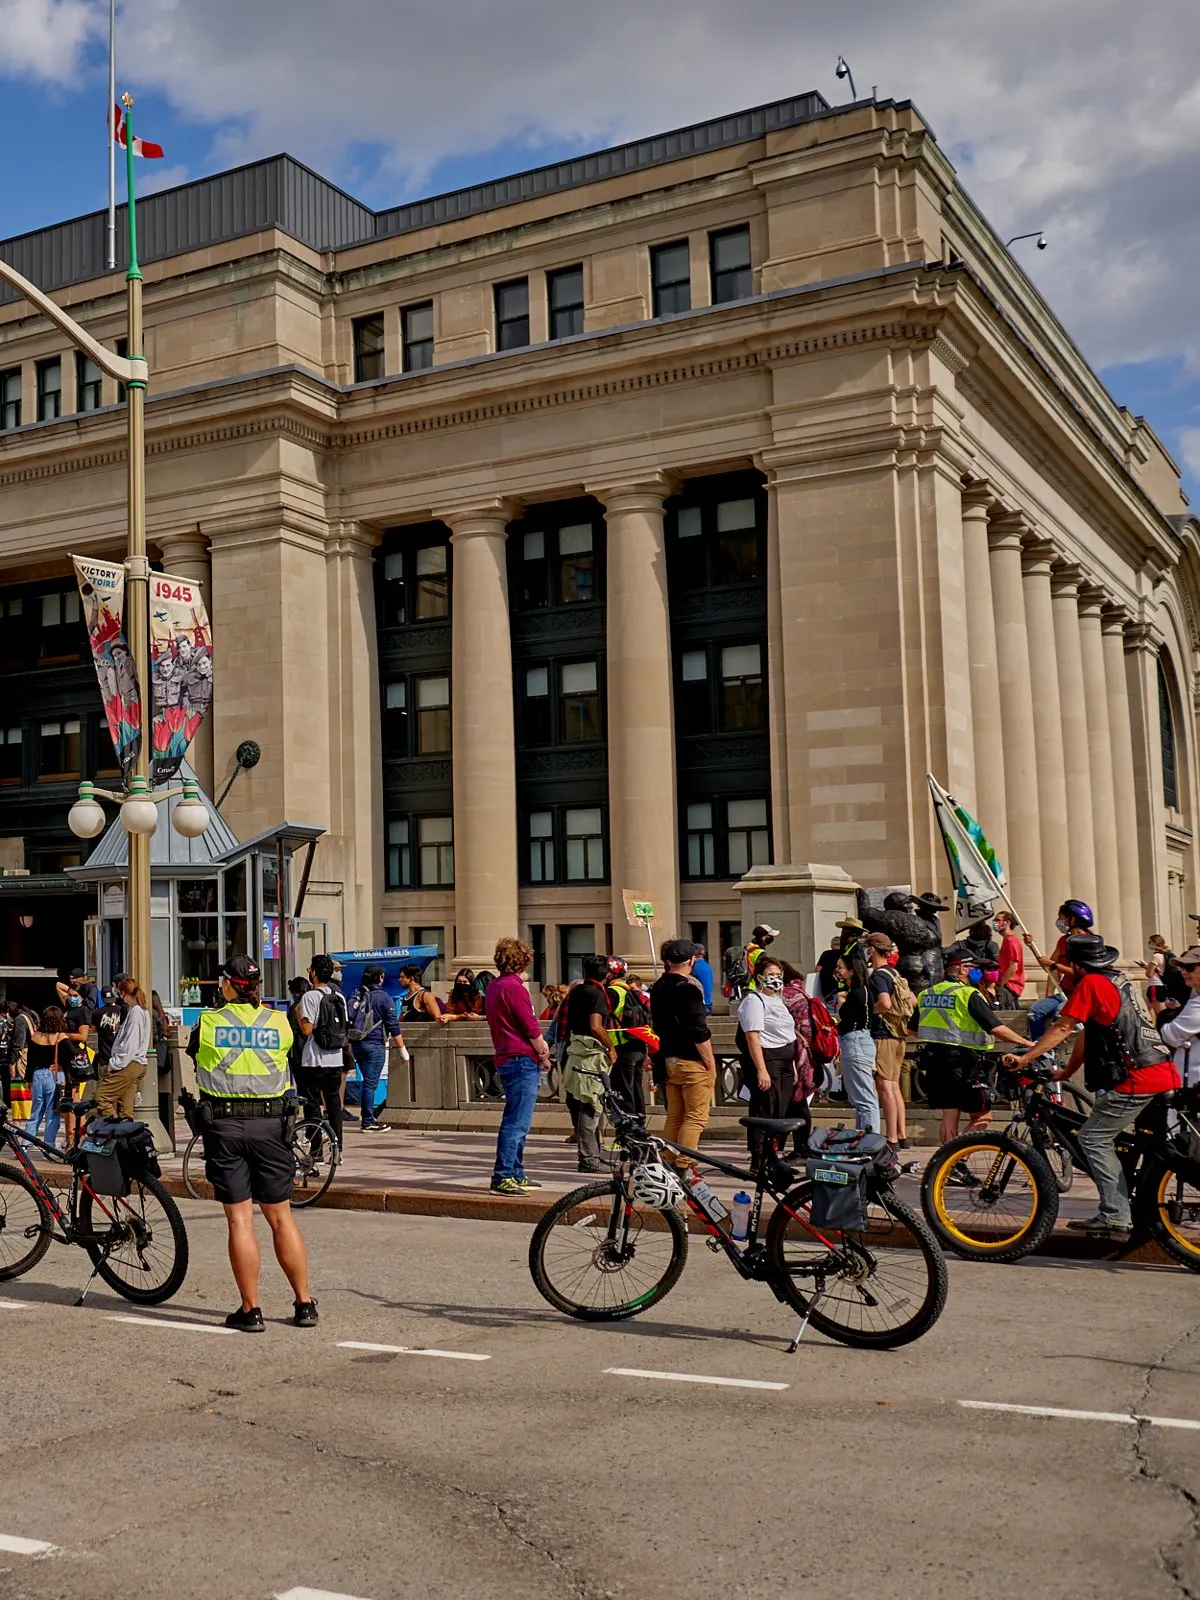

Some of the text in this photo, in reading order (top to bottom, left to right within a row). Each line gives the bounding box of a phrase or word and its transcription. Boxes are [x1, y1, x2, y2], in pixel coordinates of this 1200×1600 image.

[81, 565, 116, 579] VICTORY
[88, 576, 116, 588] TOIRE
[155, 581, 193, 603] 1945
[216, 1028, 278, 1048] POLICE
[817, 1171, 846, 1183] POLICE
[984, 1151, 1005, 1190] SONDORS
[751, 1191, 761, 1233] POLICE
